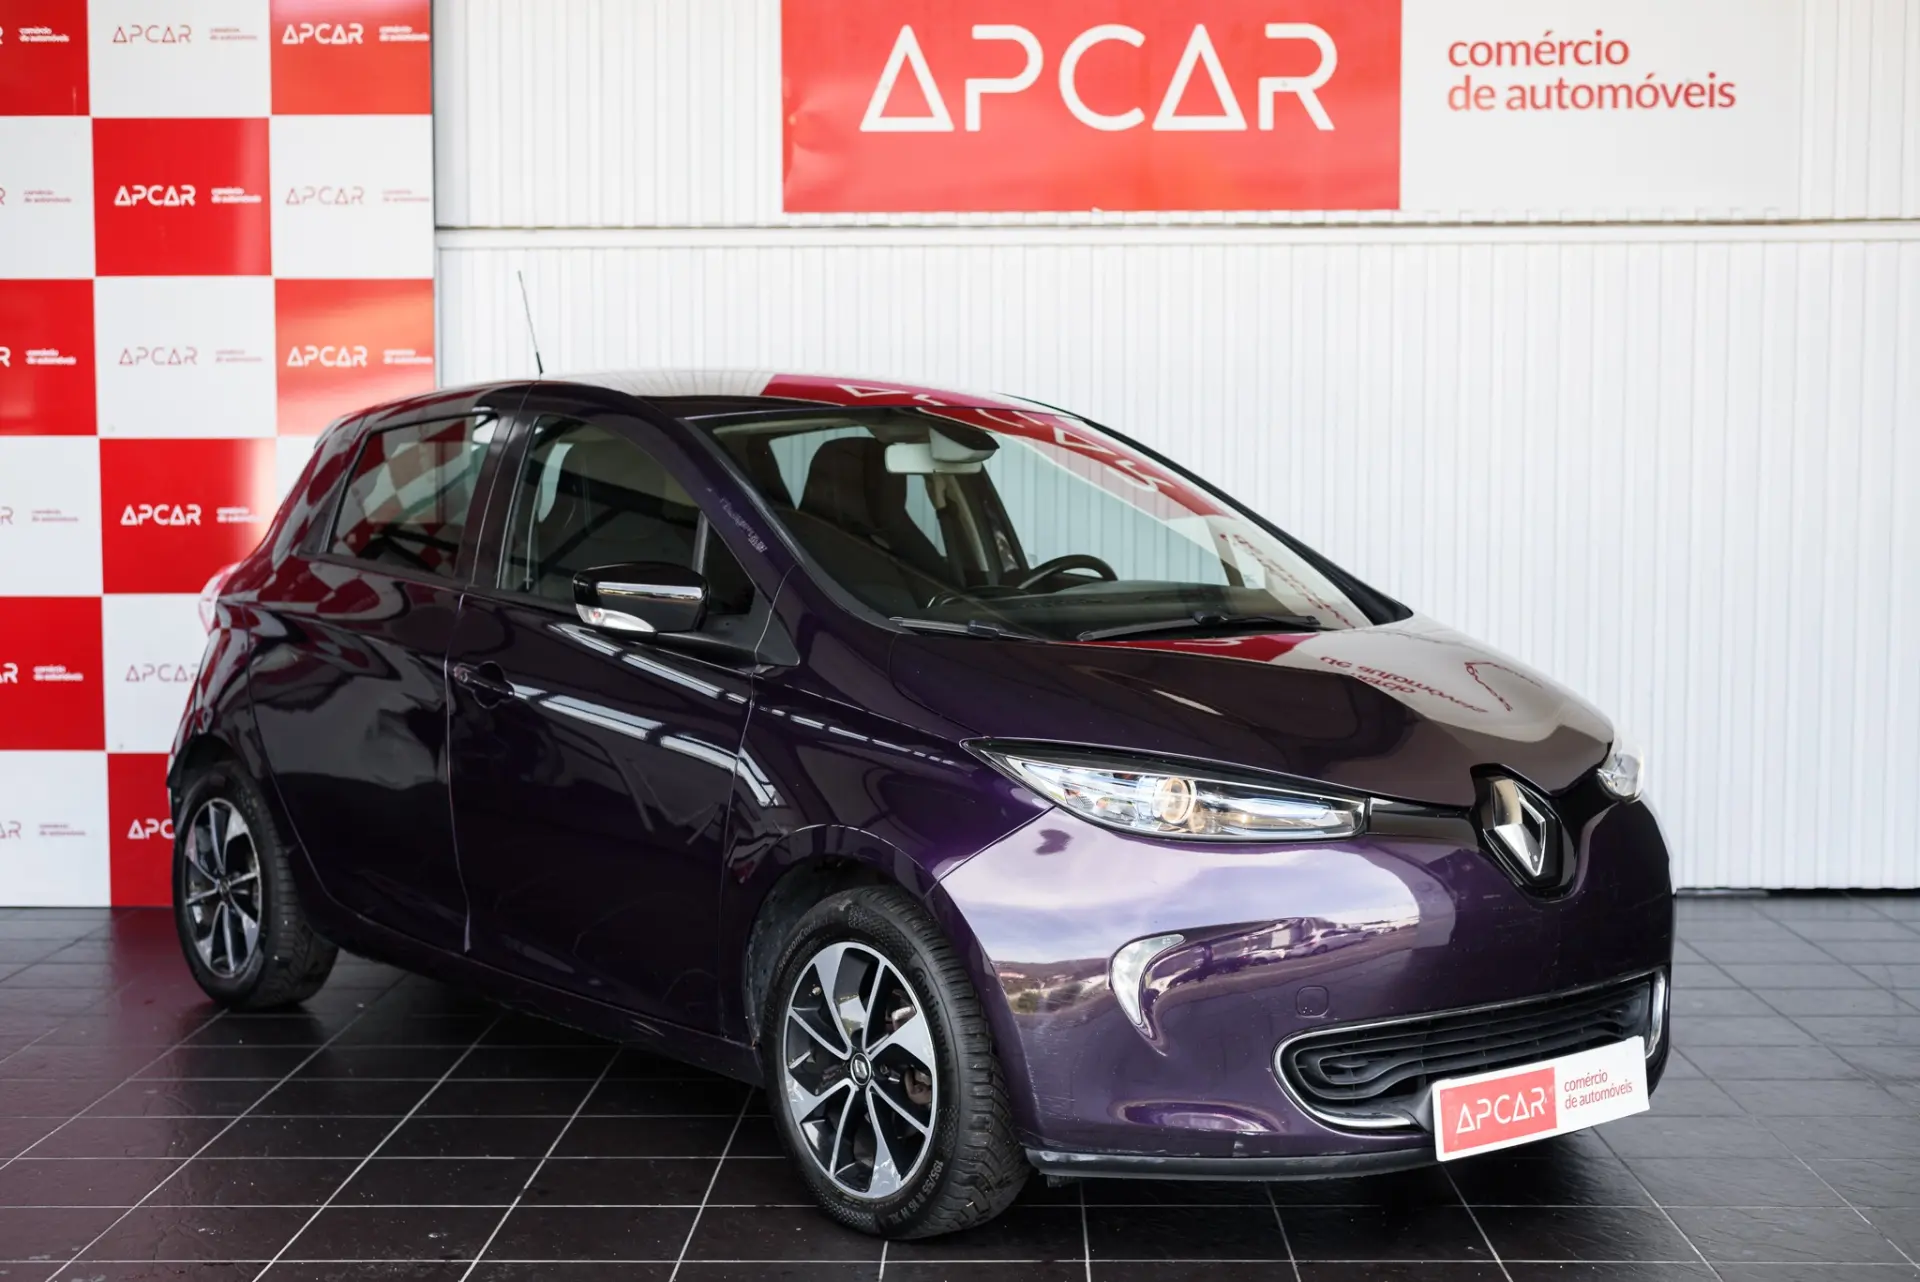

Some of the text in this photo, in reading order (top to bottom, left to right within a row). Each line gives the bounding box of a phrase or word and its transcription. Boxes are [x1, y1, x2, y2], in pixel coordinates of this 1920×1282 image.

[112, 24, 192, 44] APCAR
[282, 23, 364, 45] APCAR
[1448, 29, 1630, 67] comércio
[860, 22, 1338, 133] APCAR
[1447, 72, 1737, 111] de automóveis
[114, 185, 196, 206] APCAR
[286, 186, 364, 206] APCAR
[119, 346, 198, 366] APCAR
[287, 346, 368, 367] APCAR
[121, 504, 201, 526] APCAR
[1563, 1069, 1608, 1093] comércio
[1564, 1079, 1633, 1110] de automóveis
[1456, 1087, 1545, 1134] APCAR
[922, 1159, 945, 1196] 195/55
